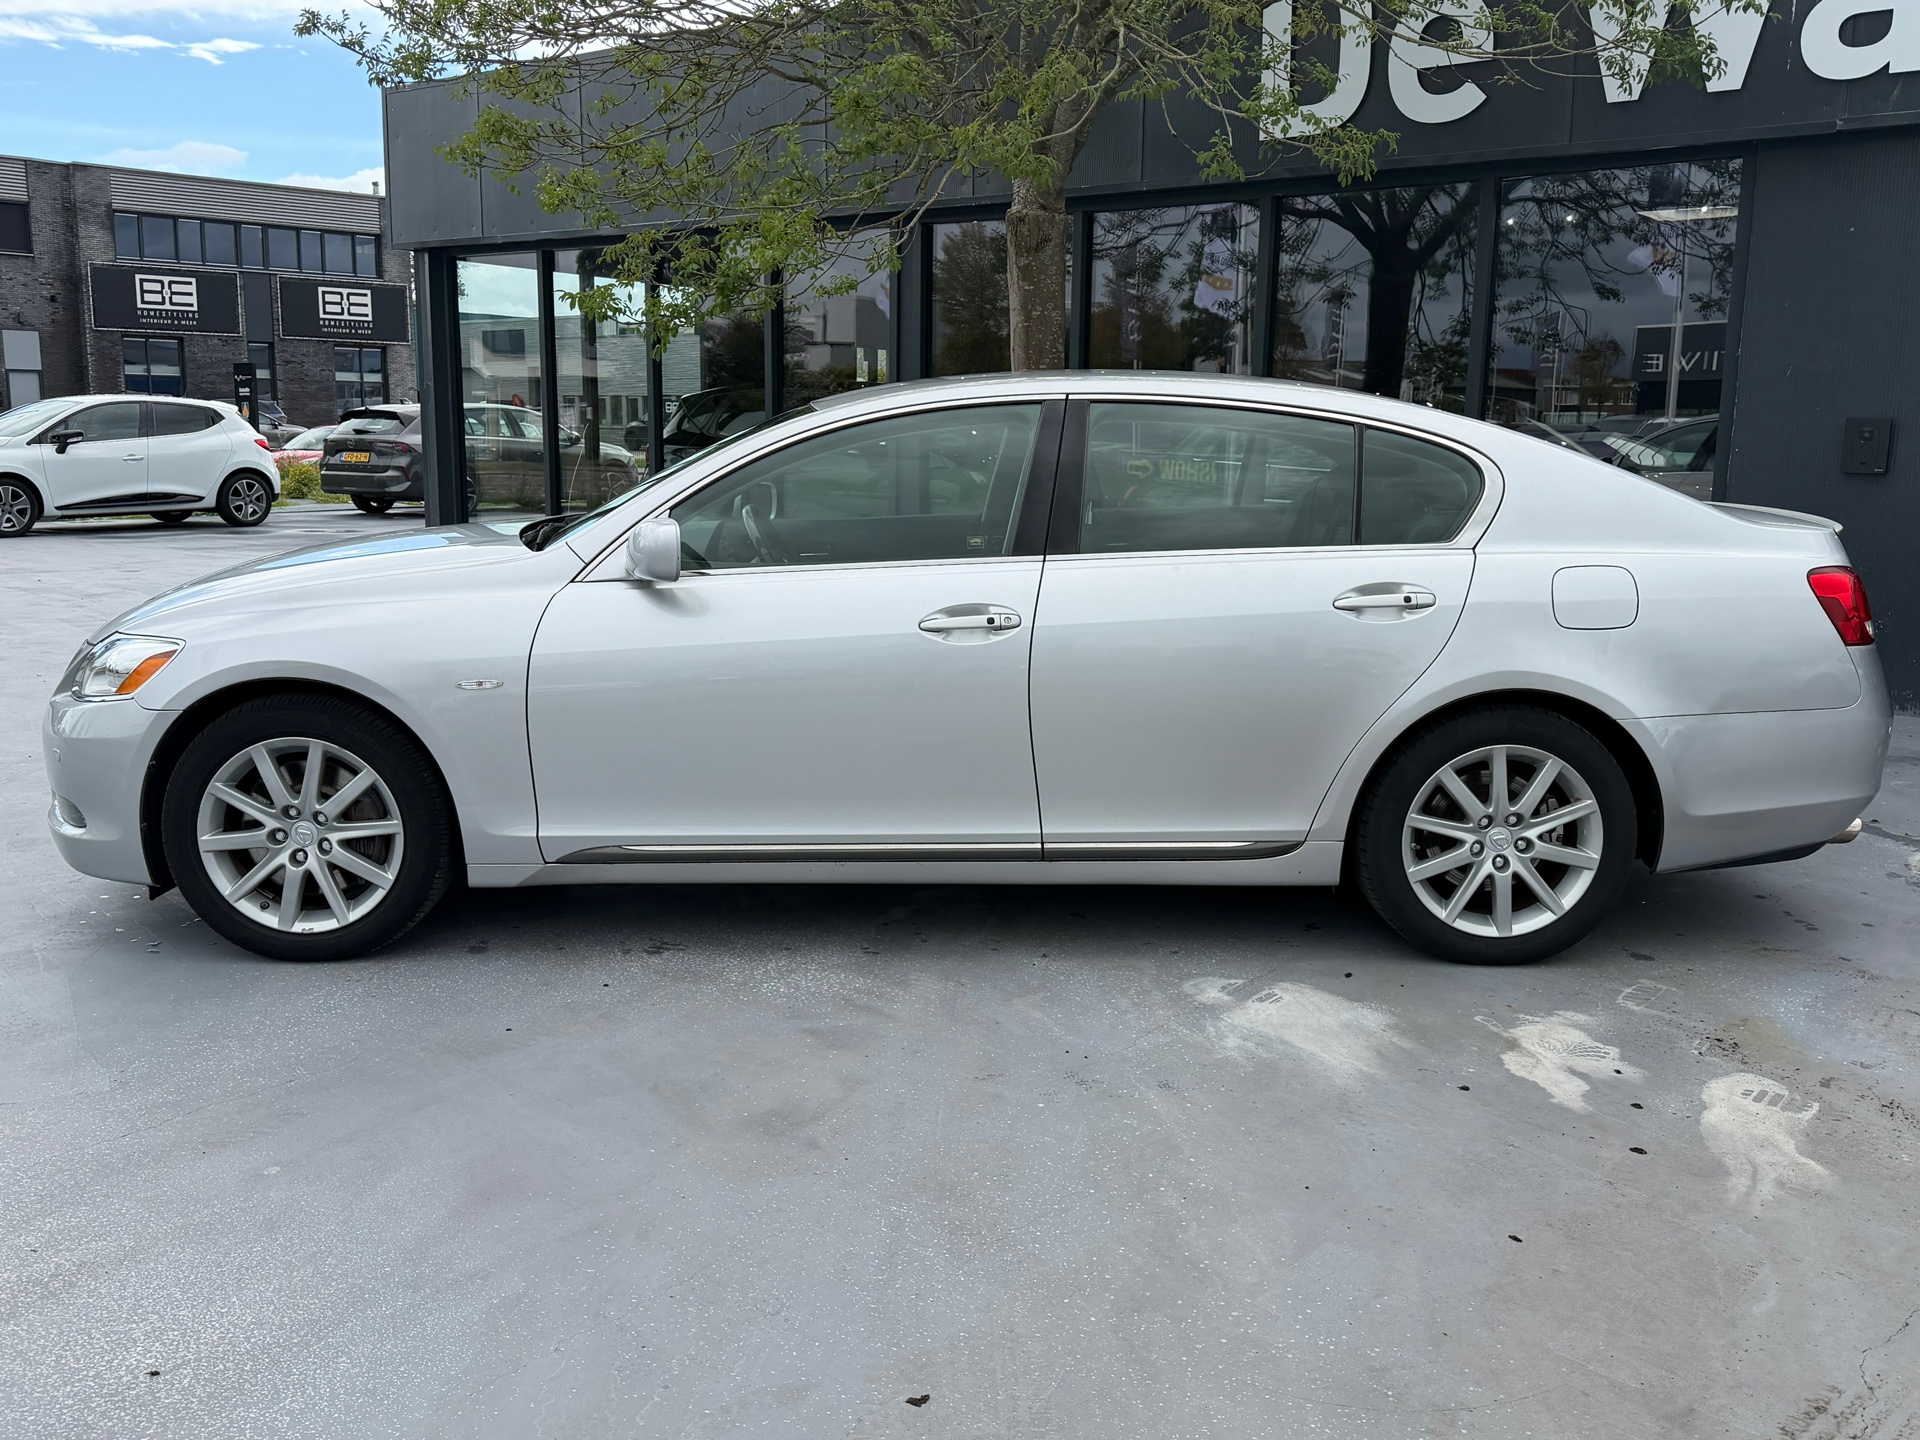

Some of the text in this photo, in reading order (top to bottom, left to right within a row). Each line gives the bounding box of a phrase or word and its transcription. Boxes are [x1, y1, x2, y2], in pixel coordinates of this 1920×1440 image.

[1259, 0, 1495, 141] De
[137, 309, 199, 319] HOMESTYLING
[319, 320, 374, 328] HOMESTYLING
